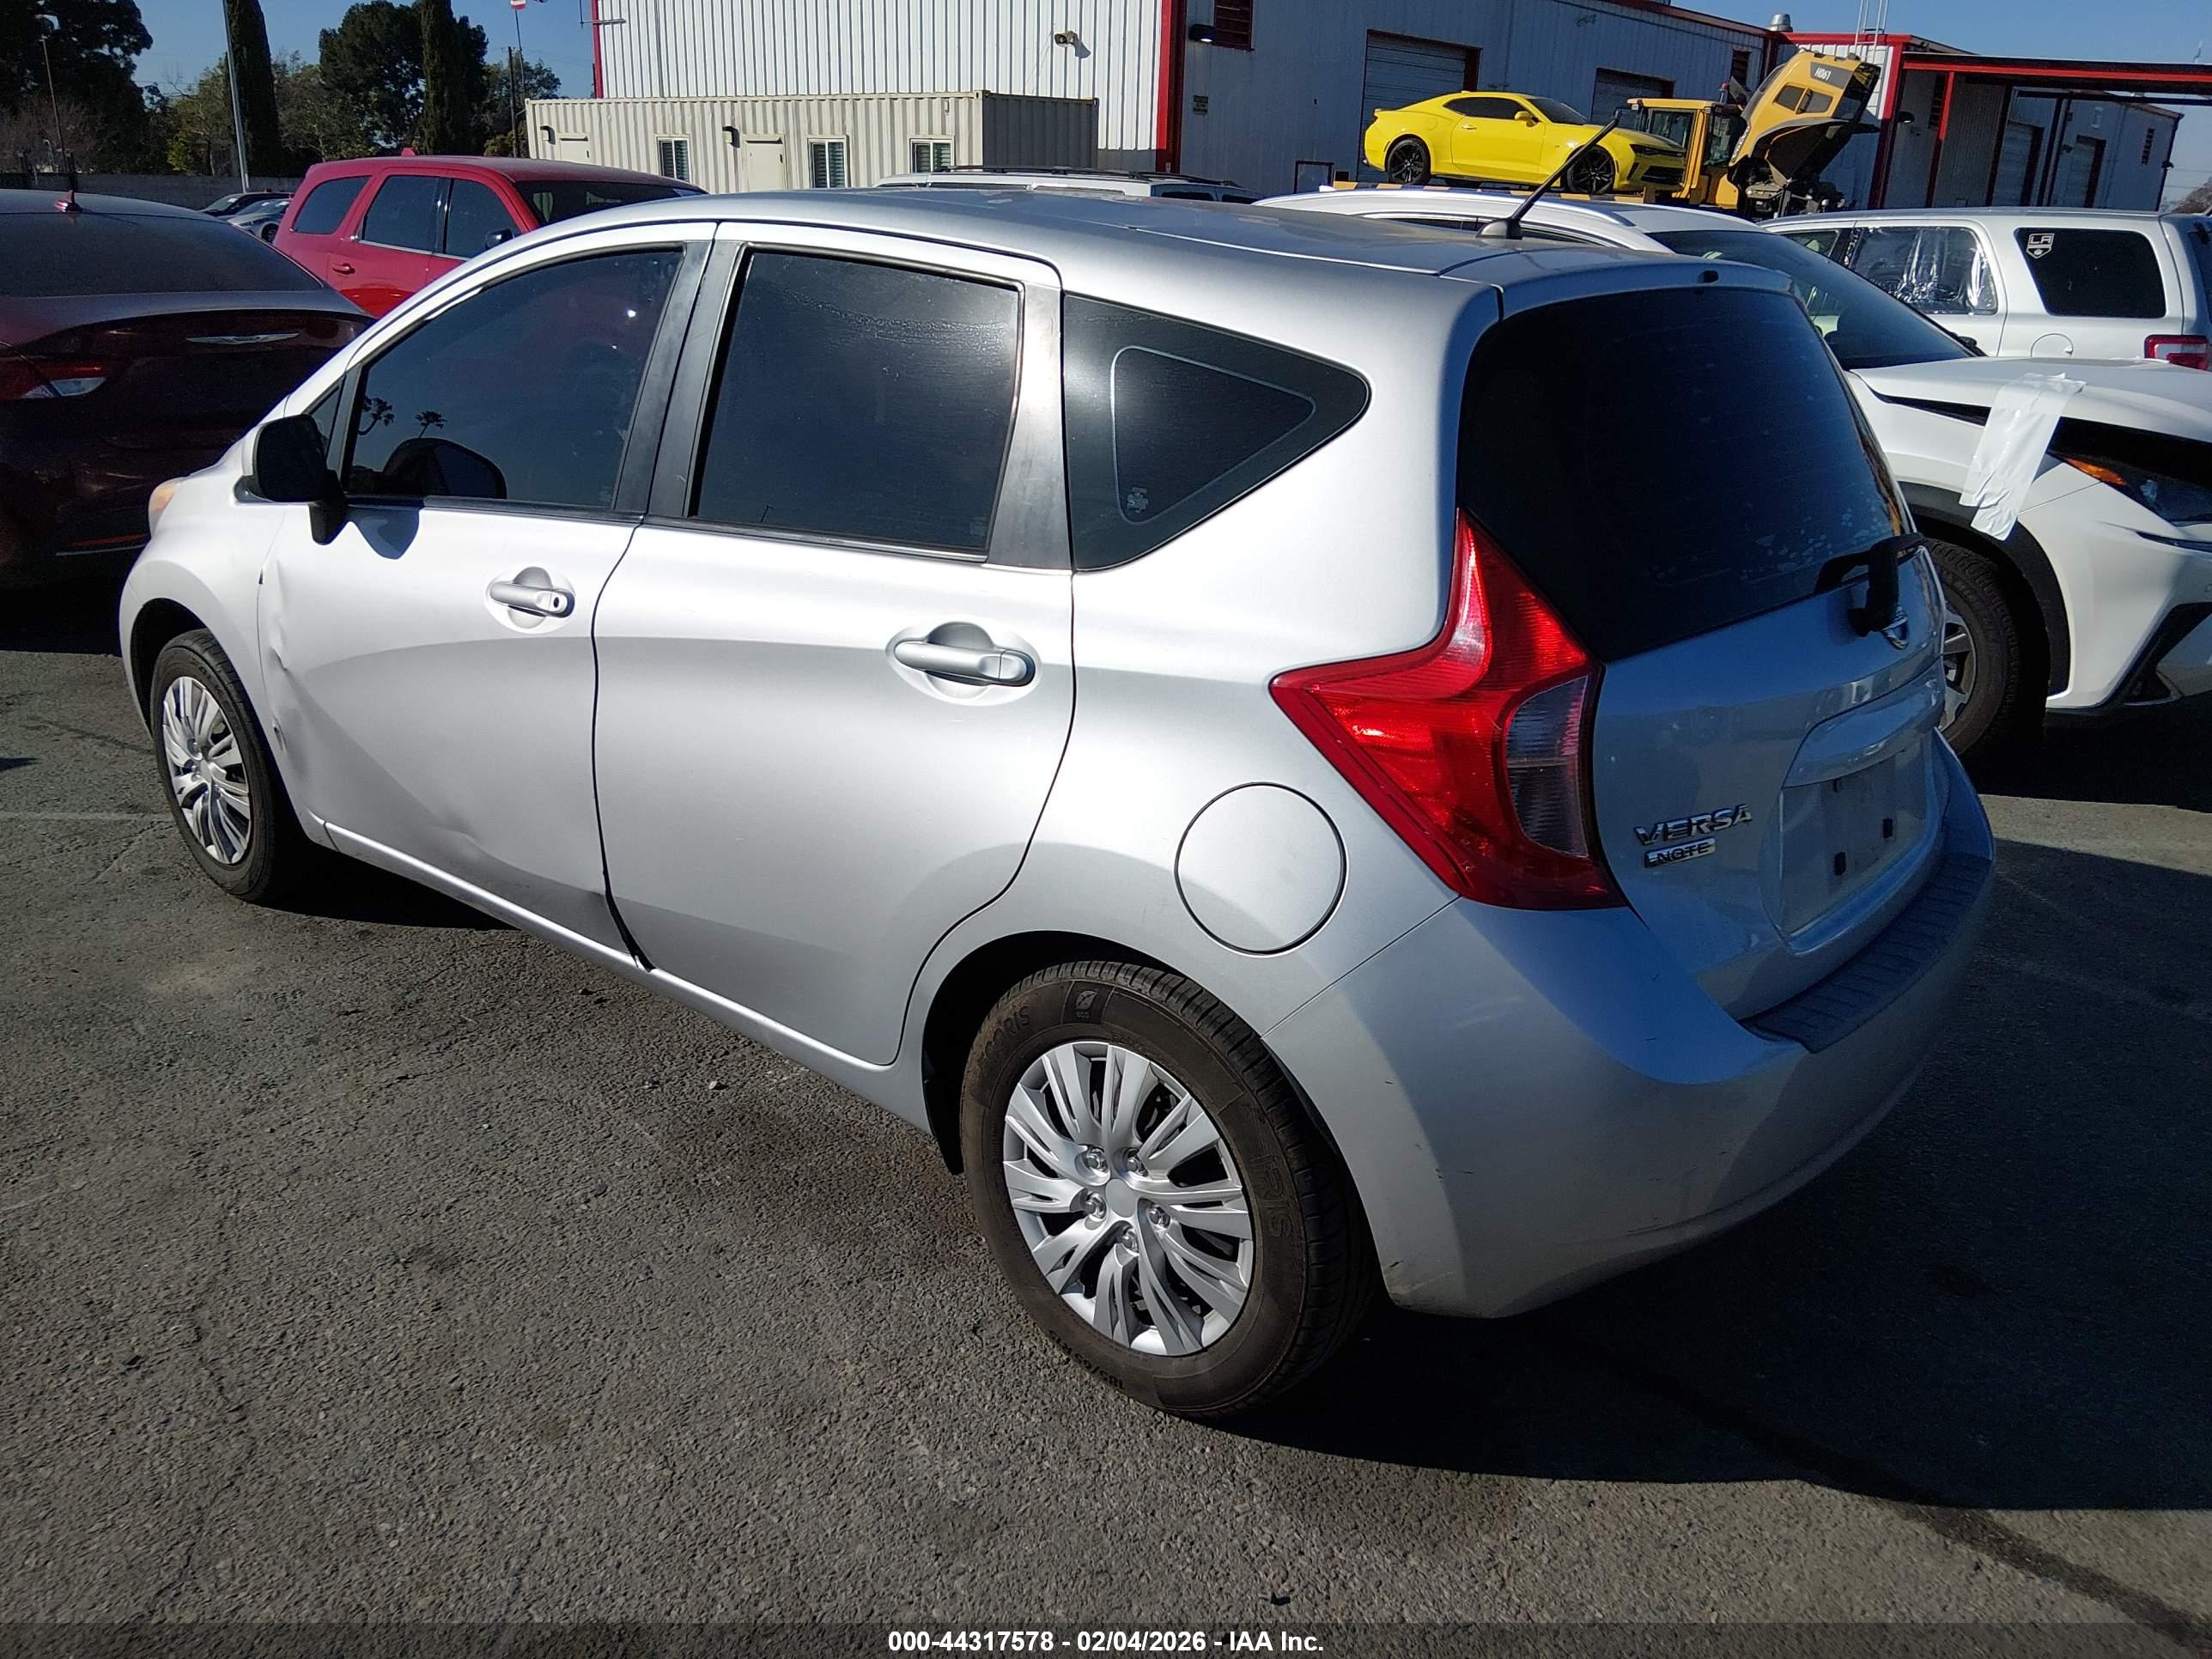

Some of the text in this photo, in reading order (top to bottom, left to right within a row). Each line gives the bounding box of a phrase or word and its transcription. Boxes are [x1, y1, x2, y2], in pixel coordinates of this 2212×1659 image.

[2030, 235, 2052, 245] LA
[1634, 804, 1753, 846] VERSA
[1650, 839, 1713, 865] NOTE
